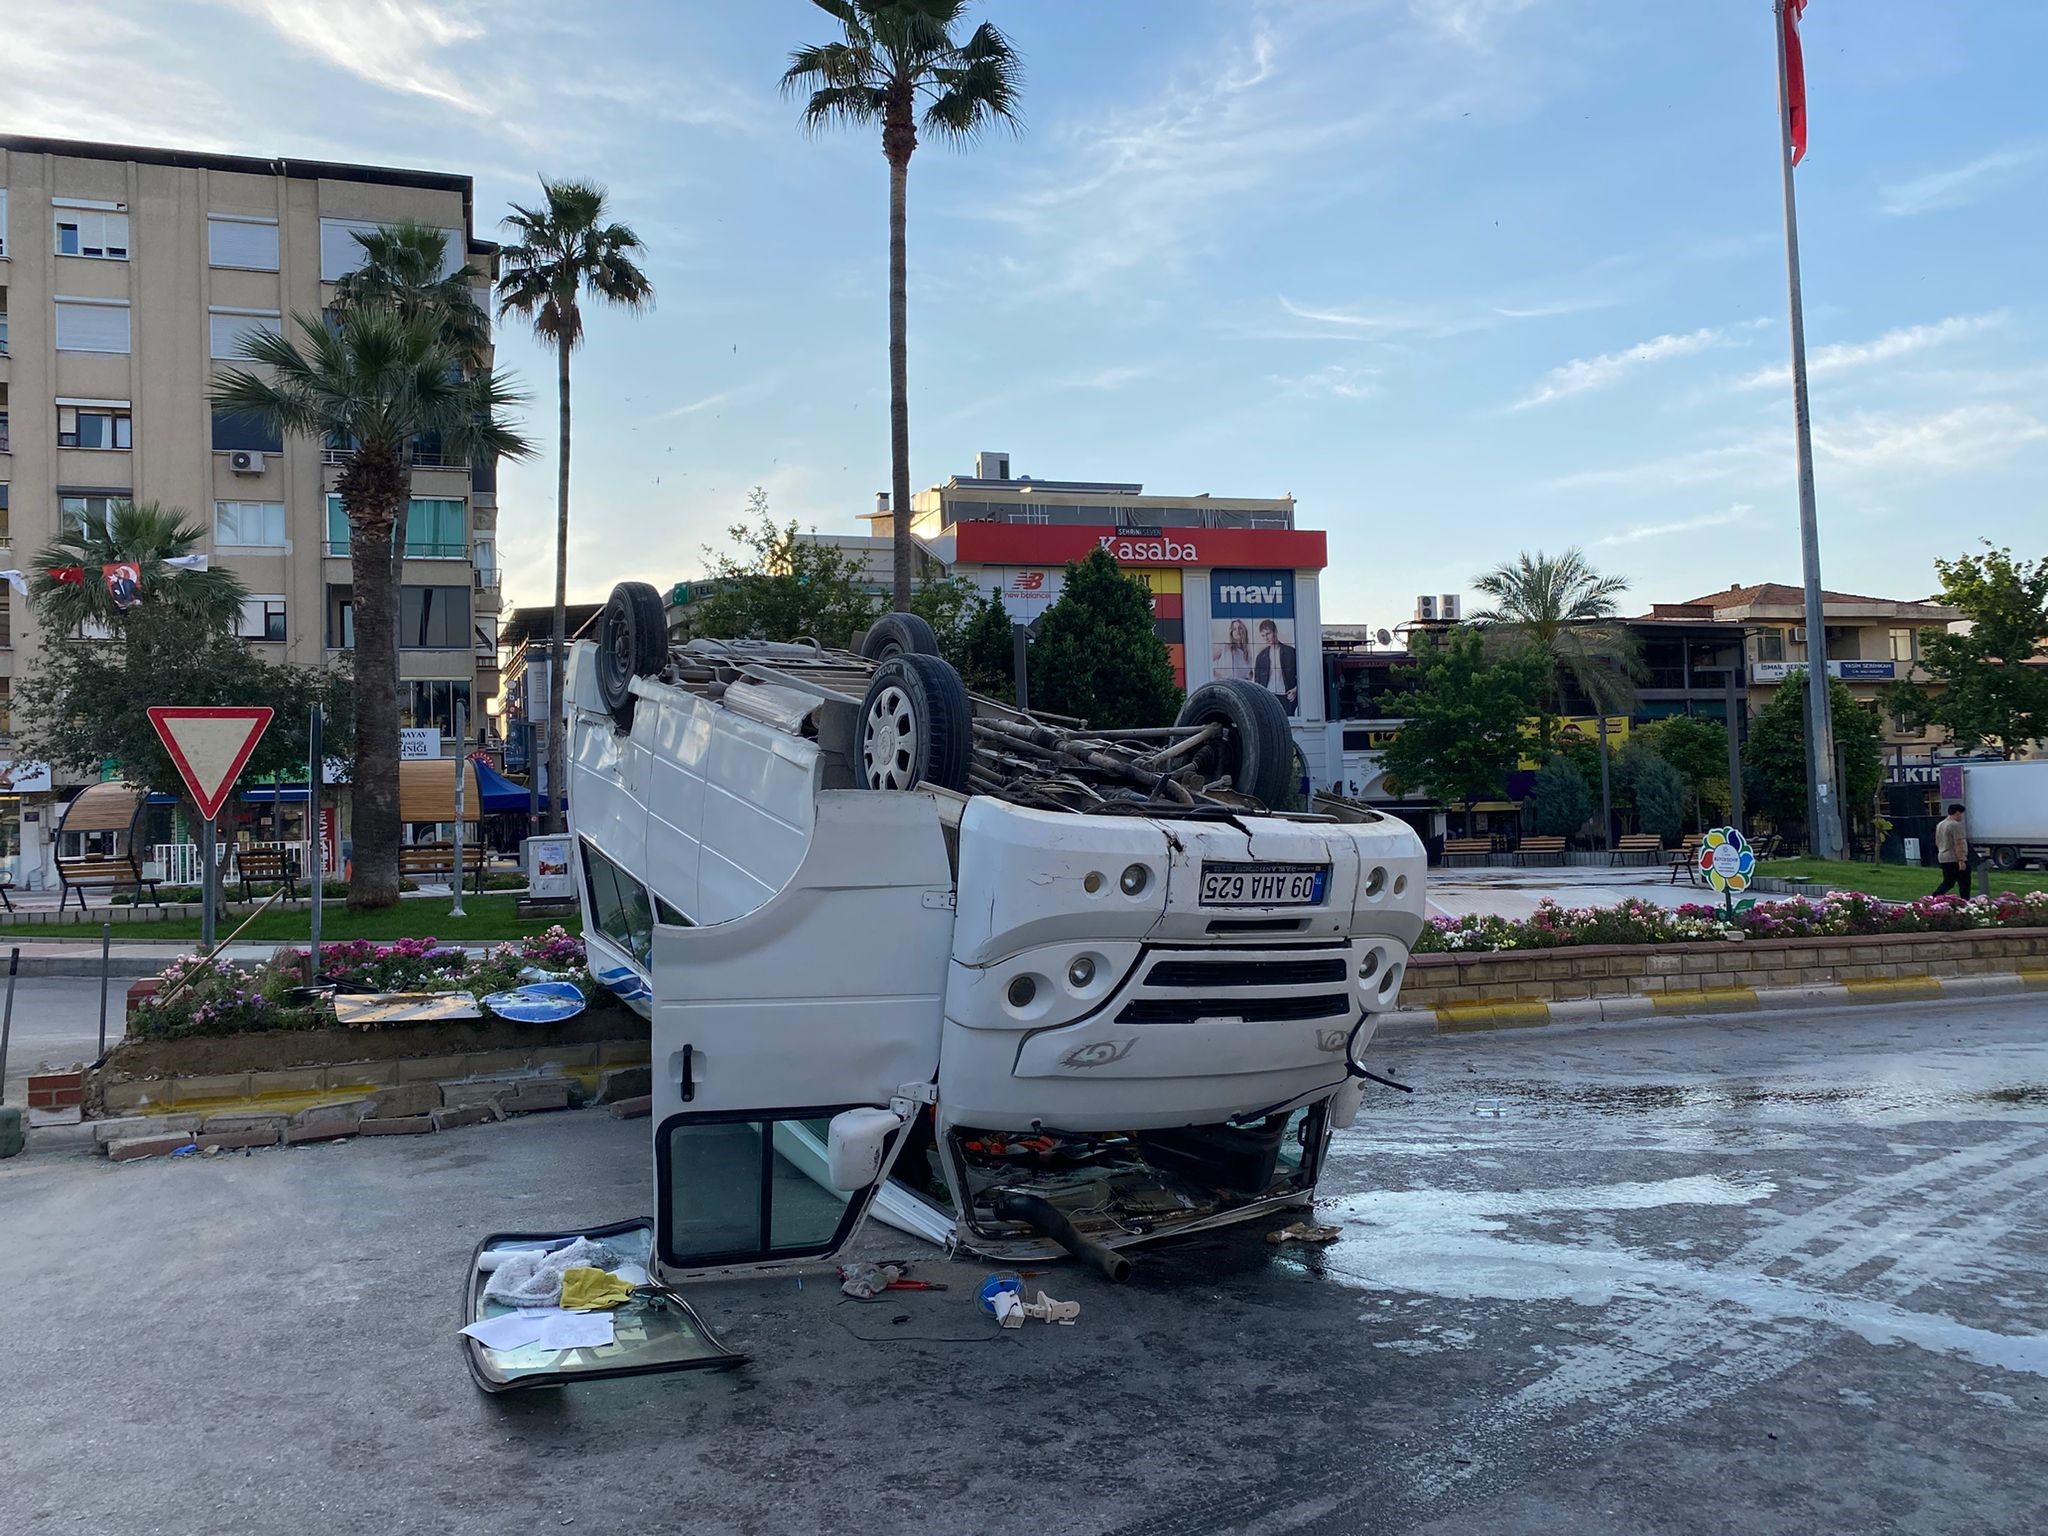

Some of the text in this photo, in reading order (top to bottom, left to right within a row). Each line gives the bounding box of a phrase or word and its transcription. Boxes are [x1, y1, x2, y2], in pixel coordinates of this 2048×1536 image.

[1099, 536, 1199, 561] Kasaba
[1220, 580, 1283, 604] mavi
[1204, 876, 1244, 899] 625
[1252, 876, 1287, 899] AHA
[1291, 876, 1314, 898] 09
